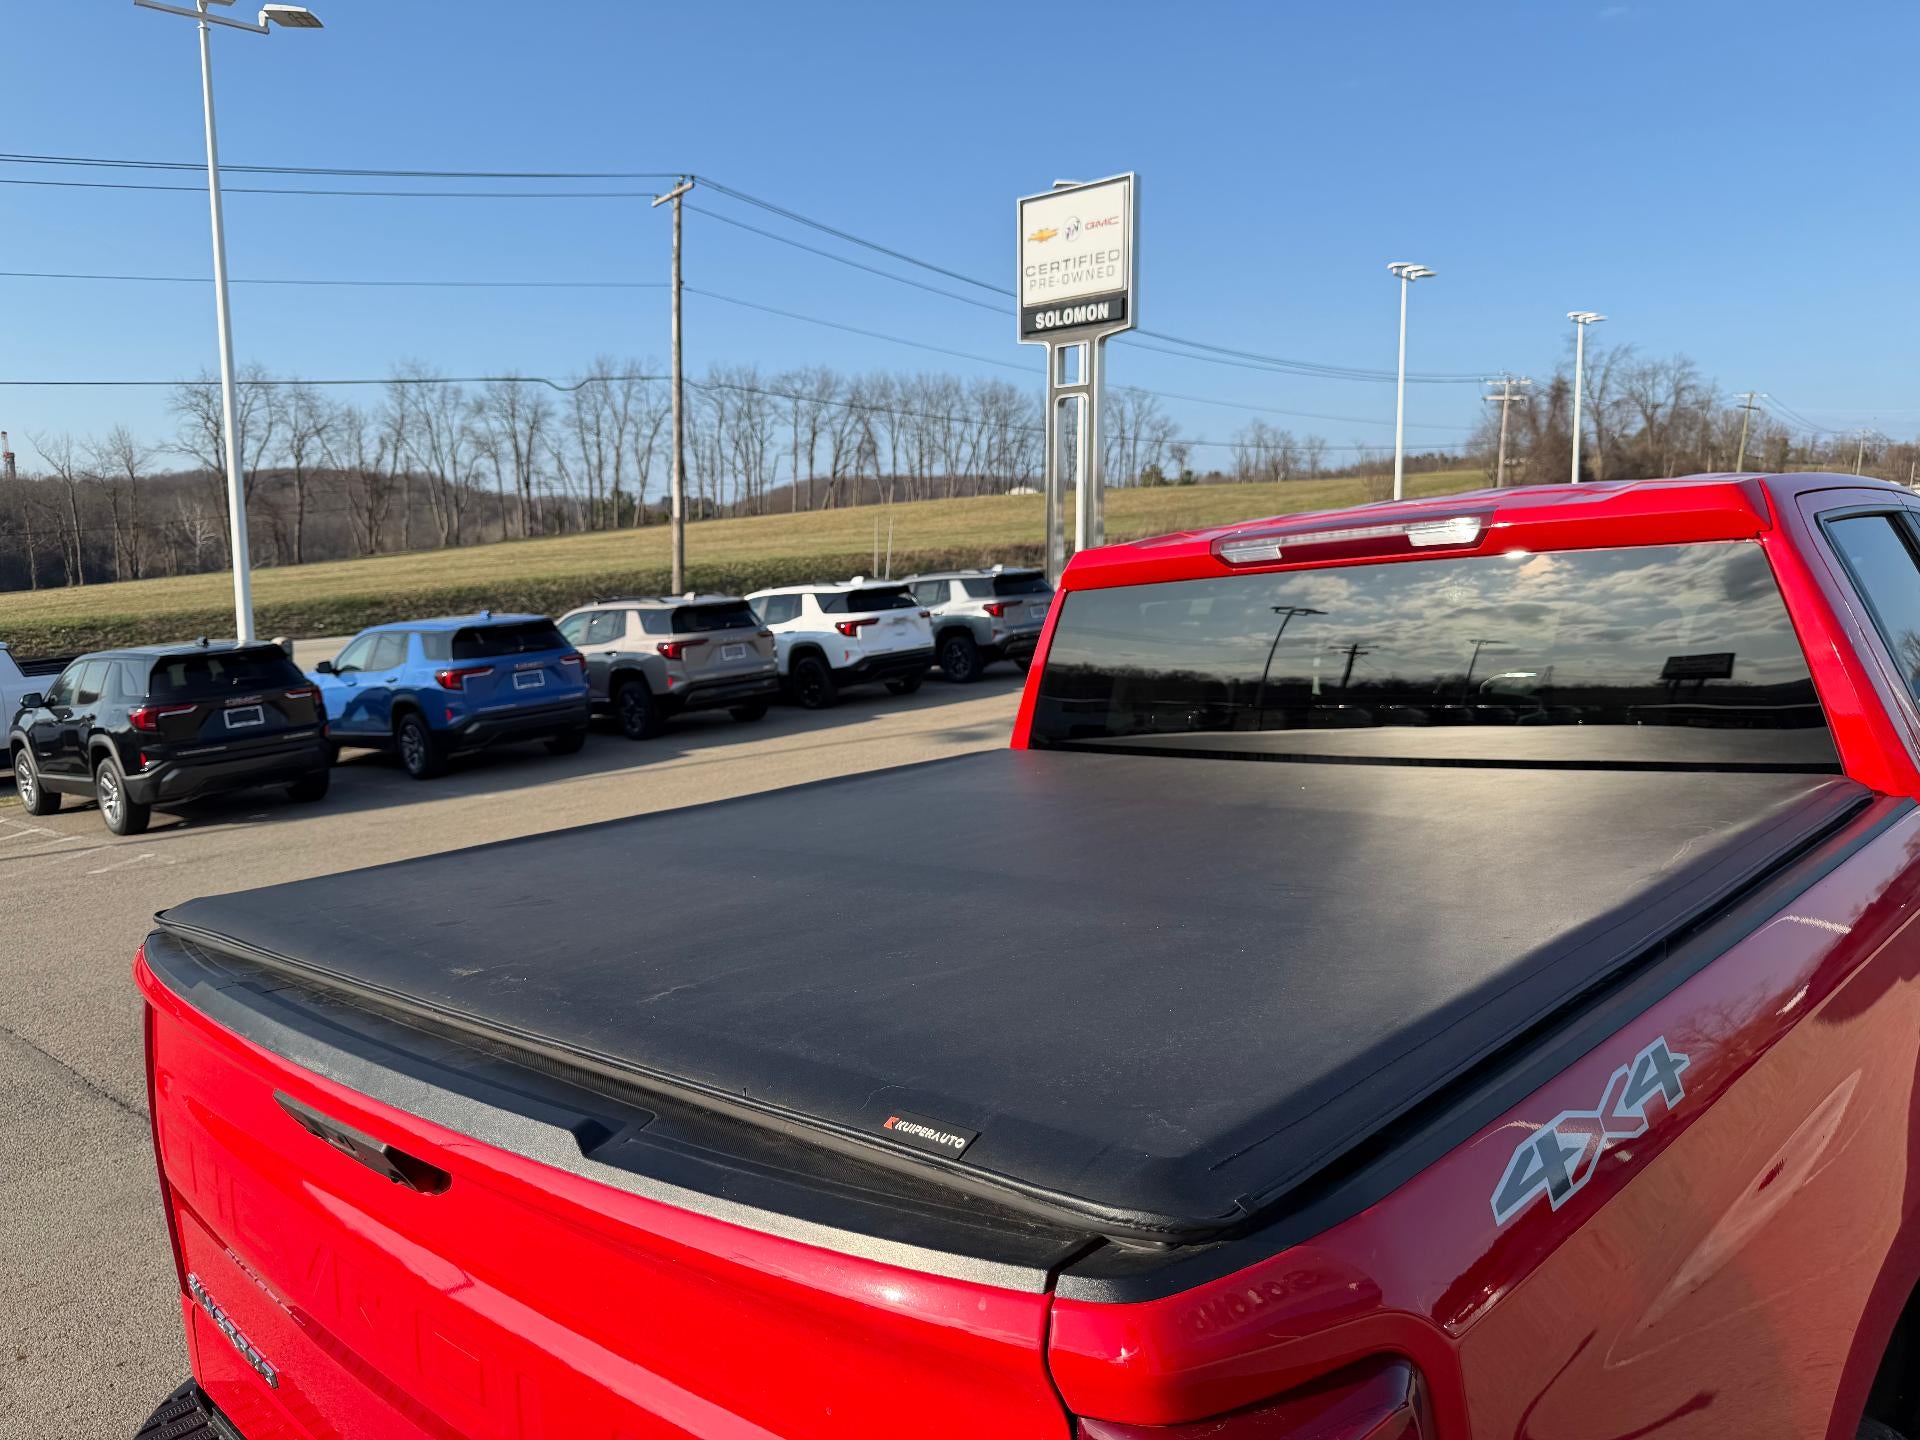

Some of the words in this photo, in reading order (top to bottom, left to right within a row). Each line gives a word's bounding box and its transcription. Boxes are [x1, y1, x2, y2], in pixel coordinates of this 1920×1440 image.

[1025, 249, 1120, 278] CERTIFIED
[1029, 265, 1115, 291] PRE-OWNED
[1035, 302, 1109, 330] SOLOMON
